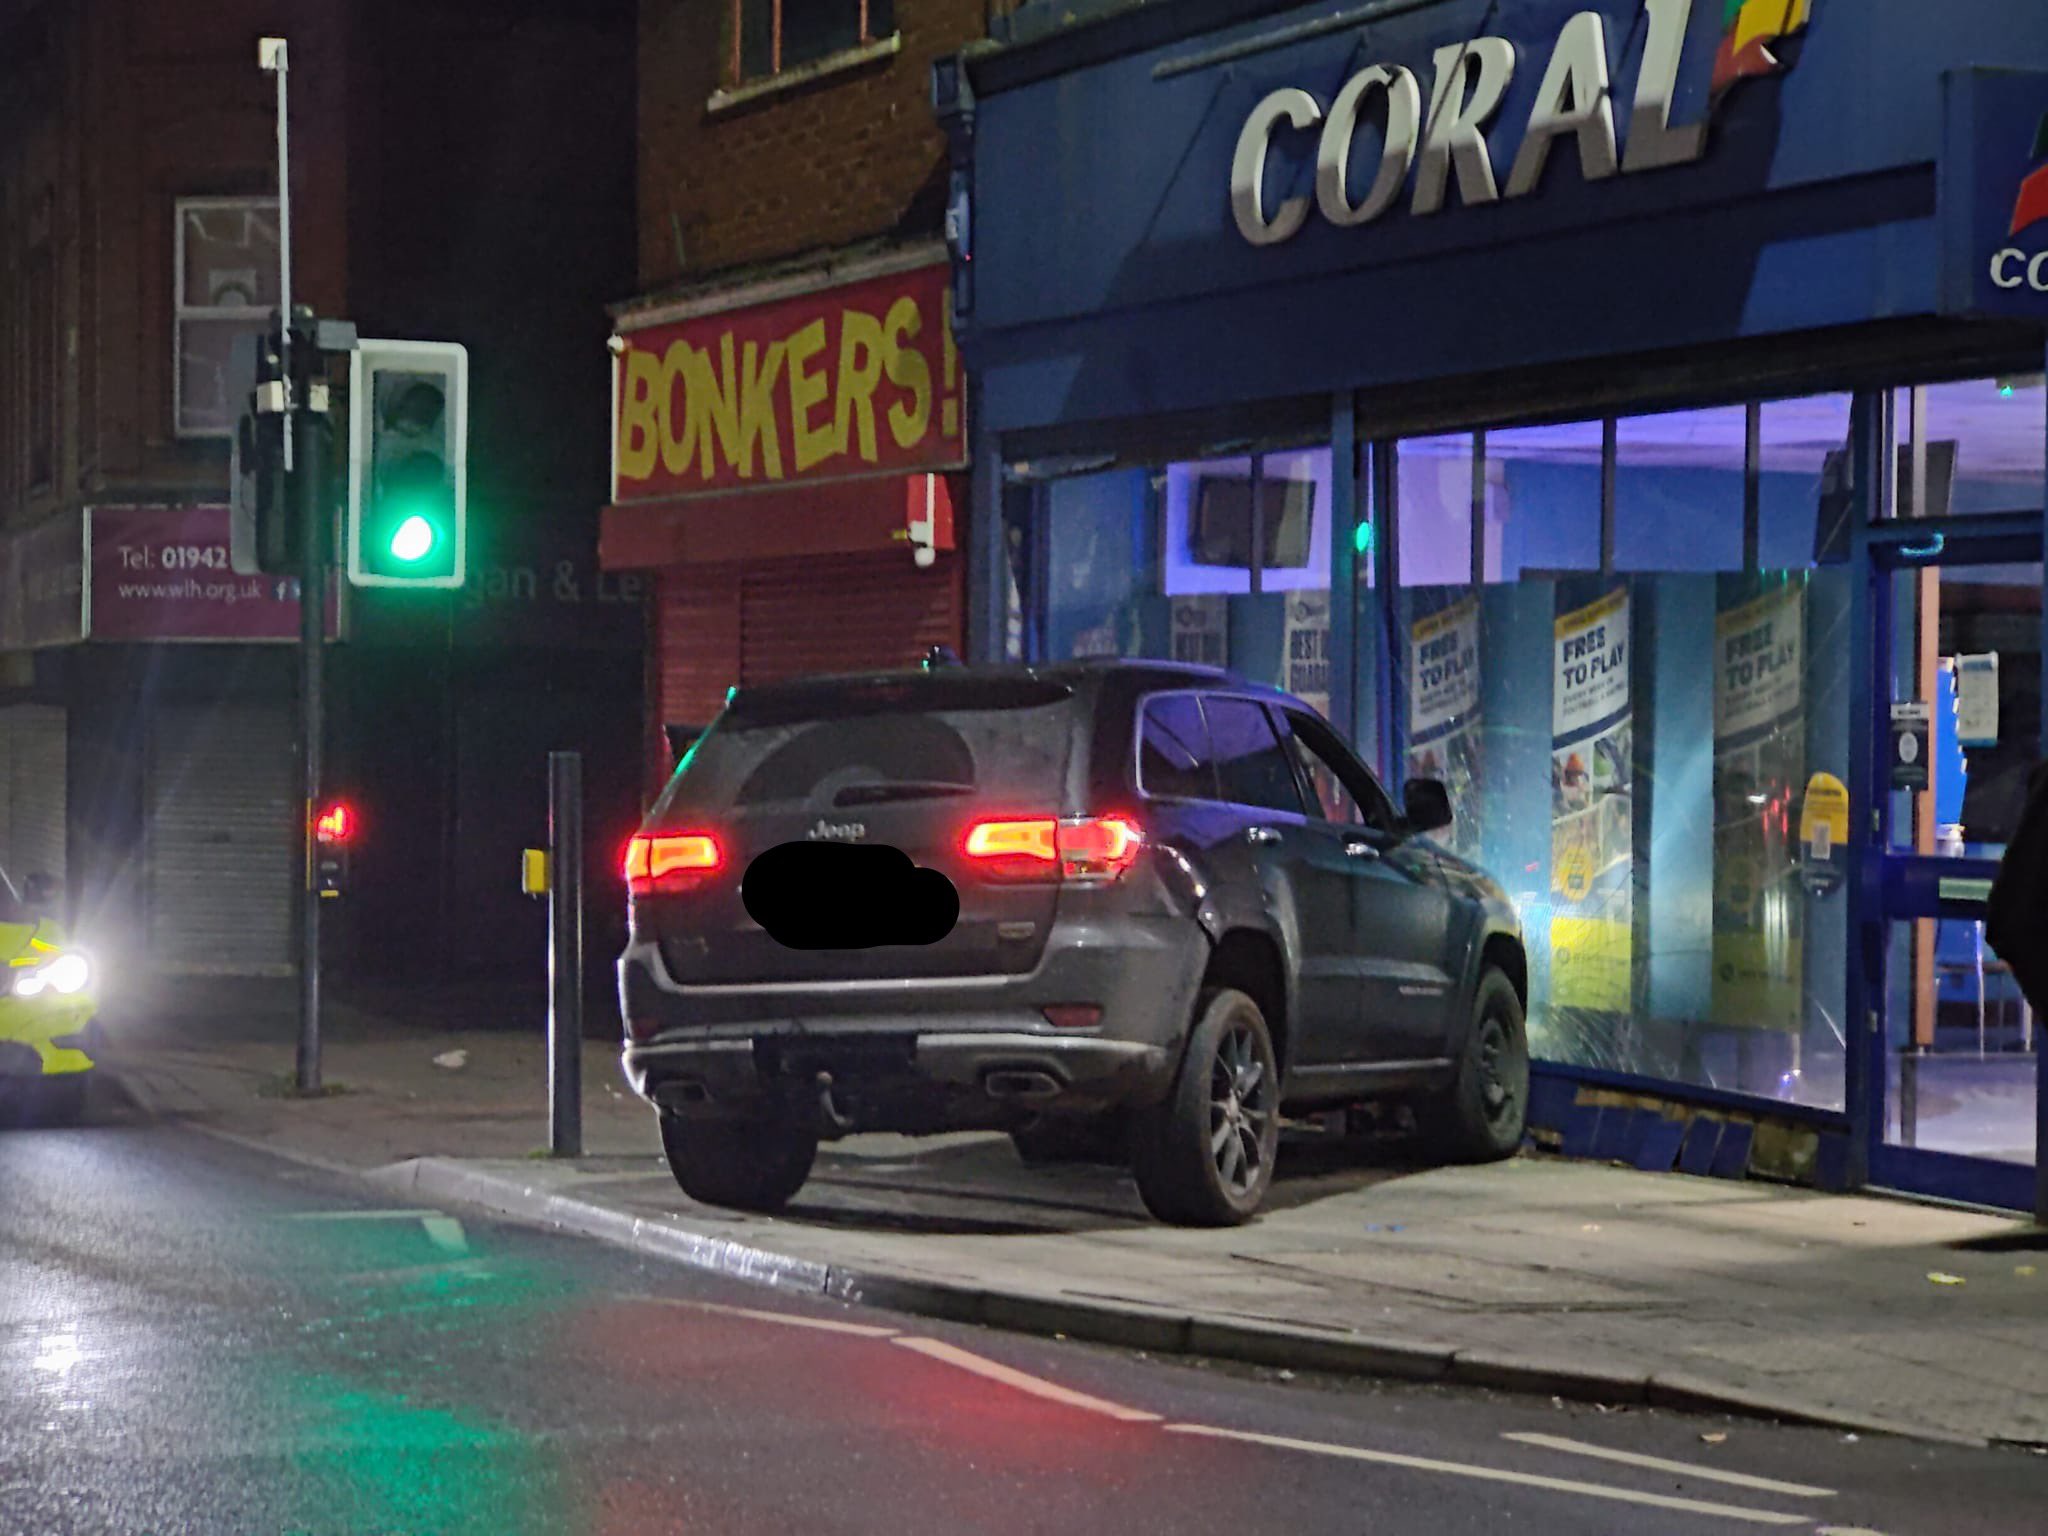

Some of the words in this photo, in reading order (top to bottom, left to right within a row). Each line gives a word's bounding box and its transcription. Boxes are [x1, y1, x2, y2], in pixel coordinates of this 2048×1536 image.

[1231, 0, 1709, 245] CORAL
[617, 287, 958, 480] BONKERS!
[118, 545, 156, 569] Tel:
[161, 546, 228, 569] 01942
[118, 578, 262, 604] www.wlh.org.uk
[466, 564, 536, 607] gan
[552, 558, 580, 603] &
[595, 569, 650, 602] Le
[1562, 662, 1588, 689] TO
[1590, 640, 1625, 679] PLAY
[1563, 626, 1605, 663] FREE
[808, 818, 865, 842] Jeep
